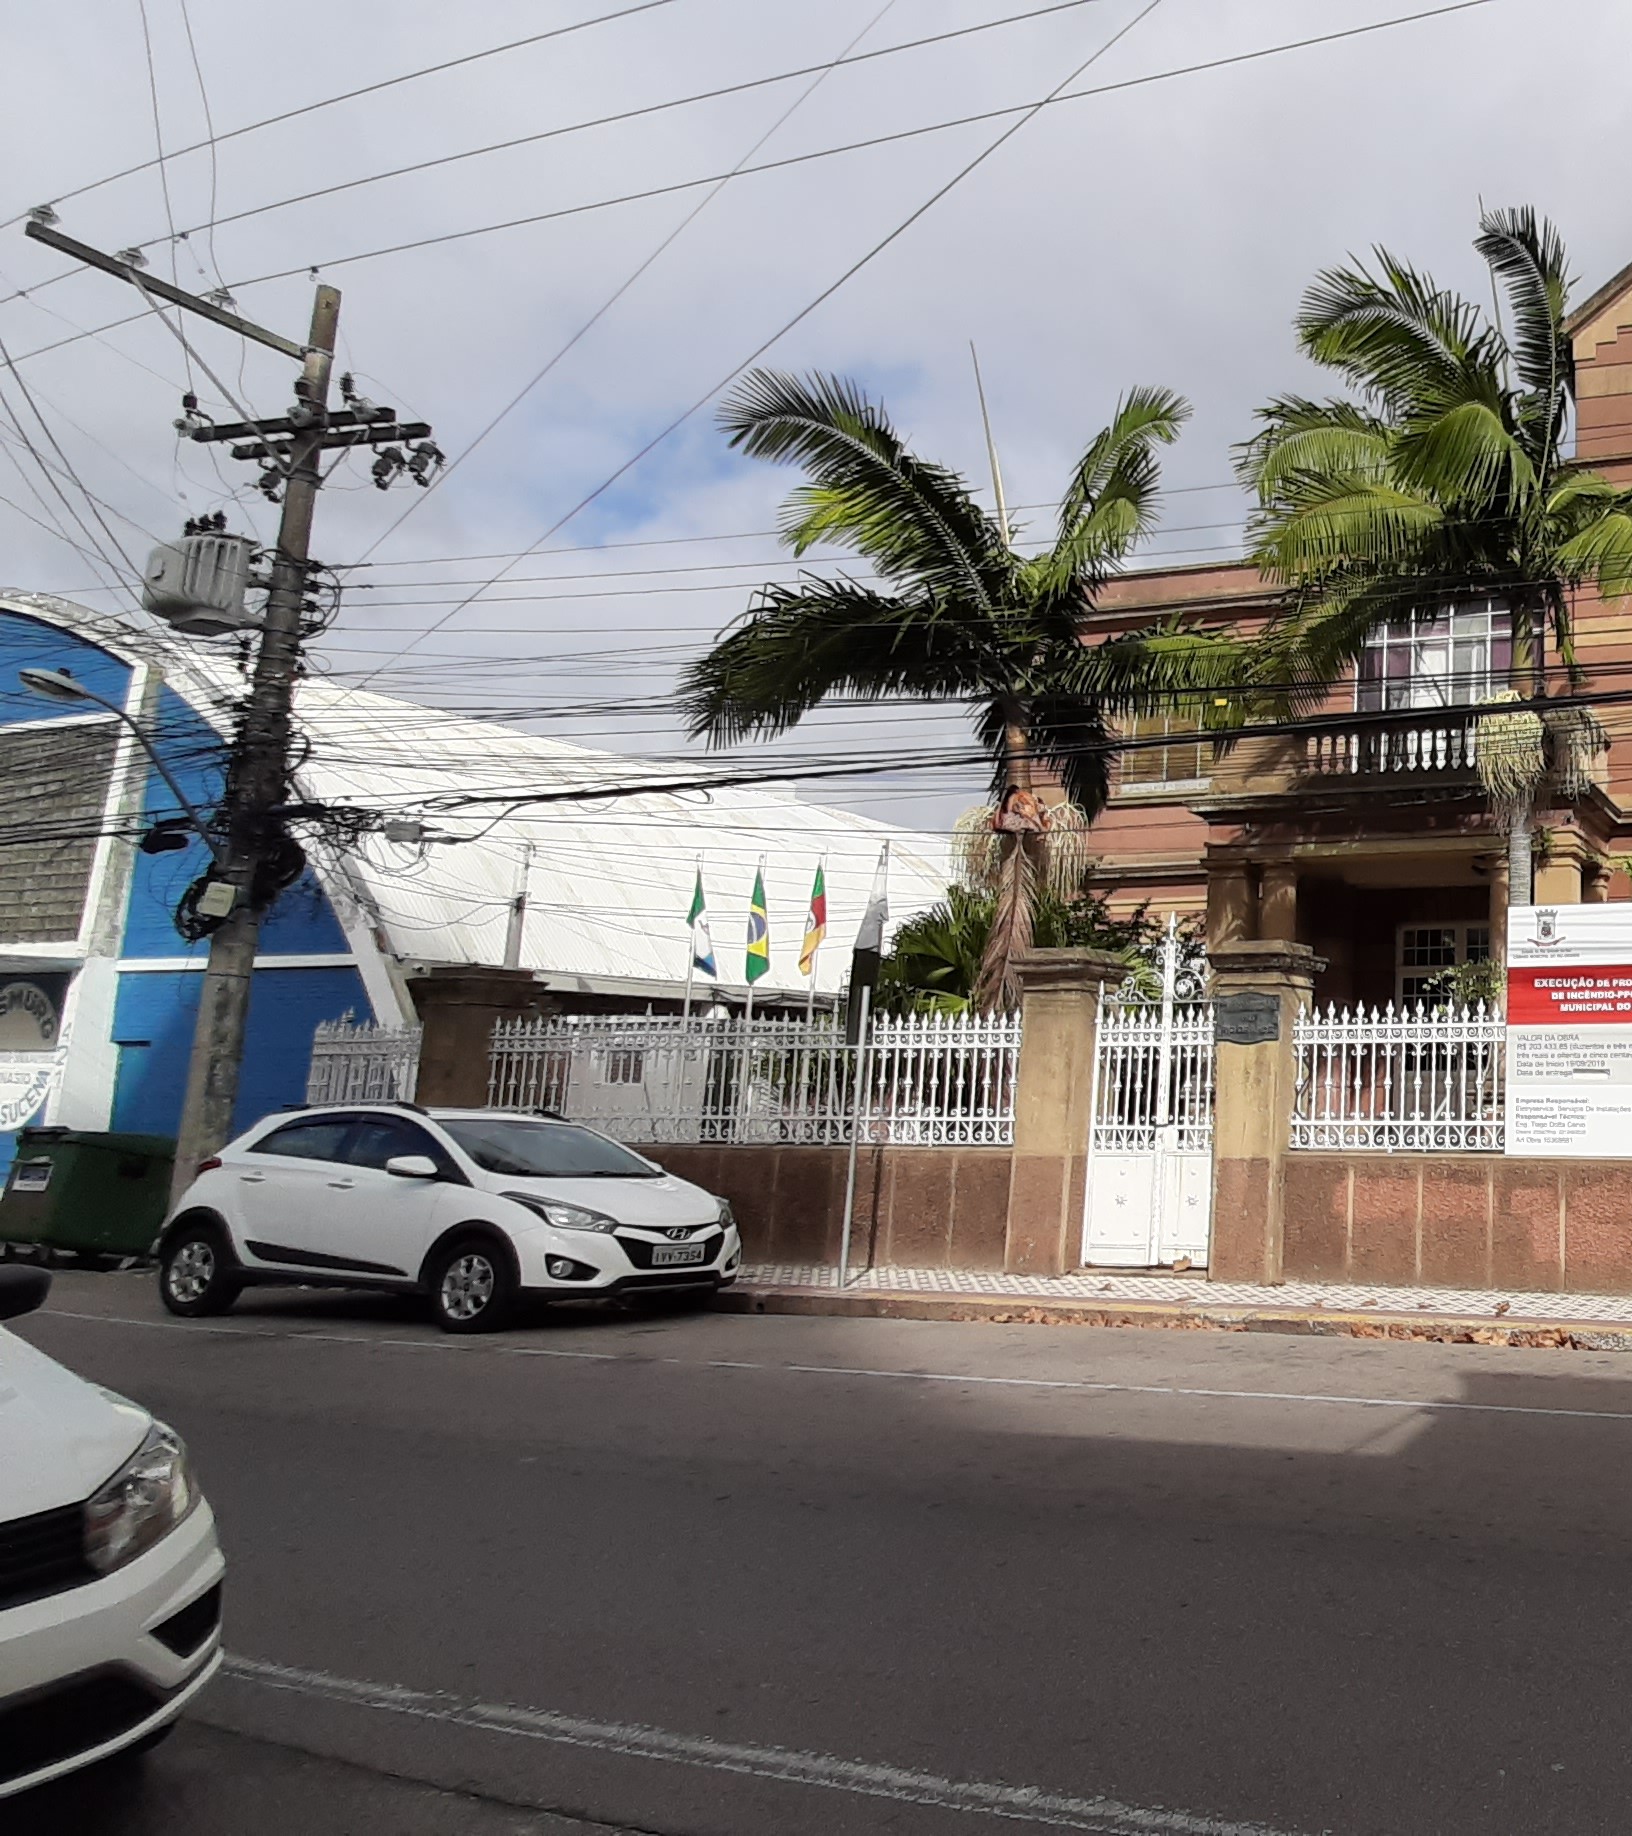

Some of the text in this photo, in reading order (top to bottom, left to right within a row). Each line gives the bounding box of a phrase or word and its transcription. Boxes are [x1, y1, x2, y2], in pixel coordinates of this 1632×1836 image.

[1533, 976, 1594, 989] EXECUÇÃO
[1596, 979, 1610, 987] DE
[1551, 991, 1564, 1000] DE
[1559, 1003, 1614, 1012] MUNICIPAL
[1616, 1002, 1631, 1011] DO
